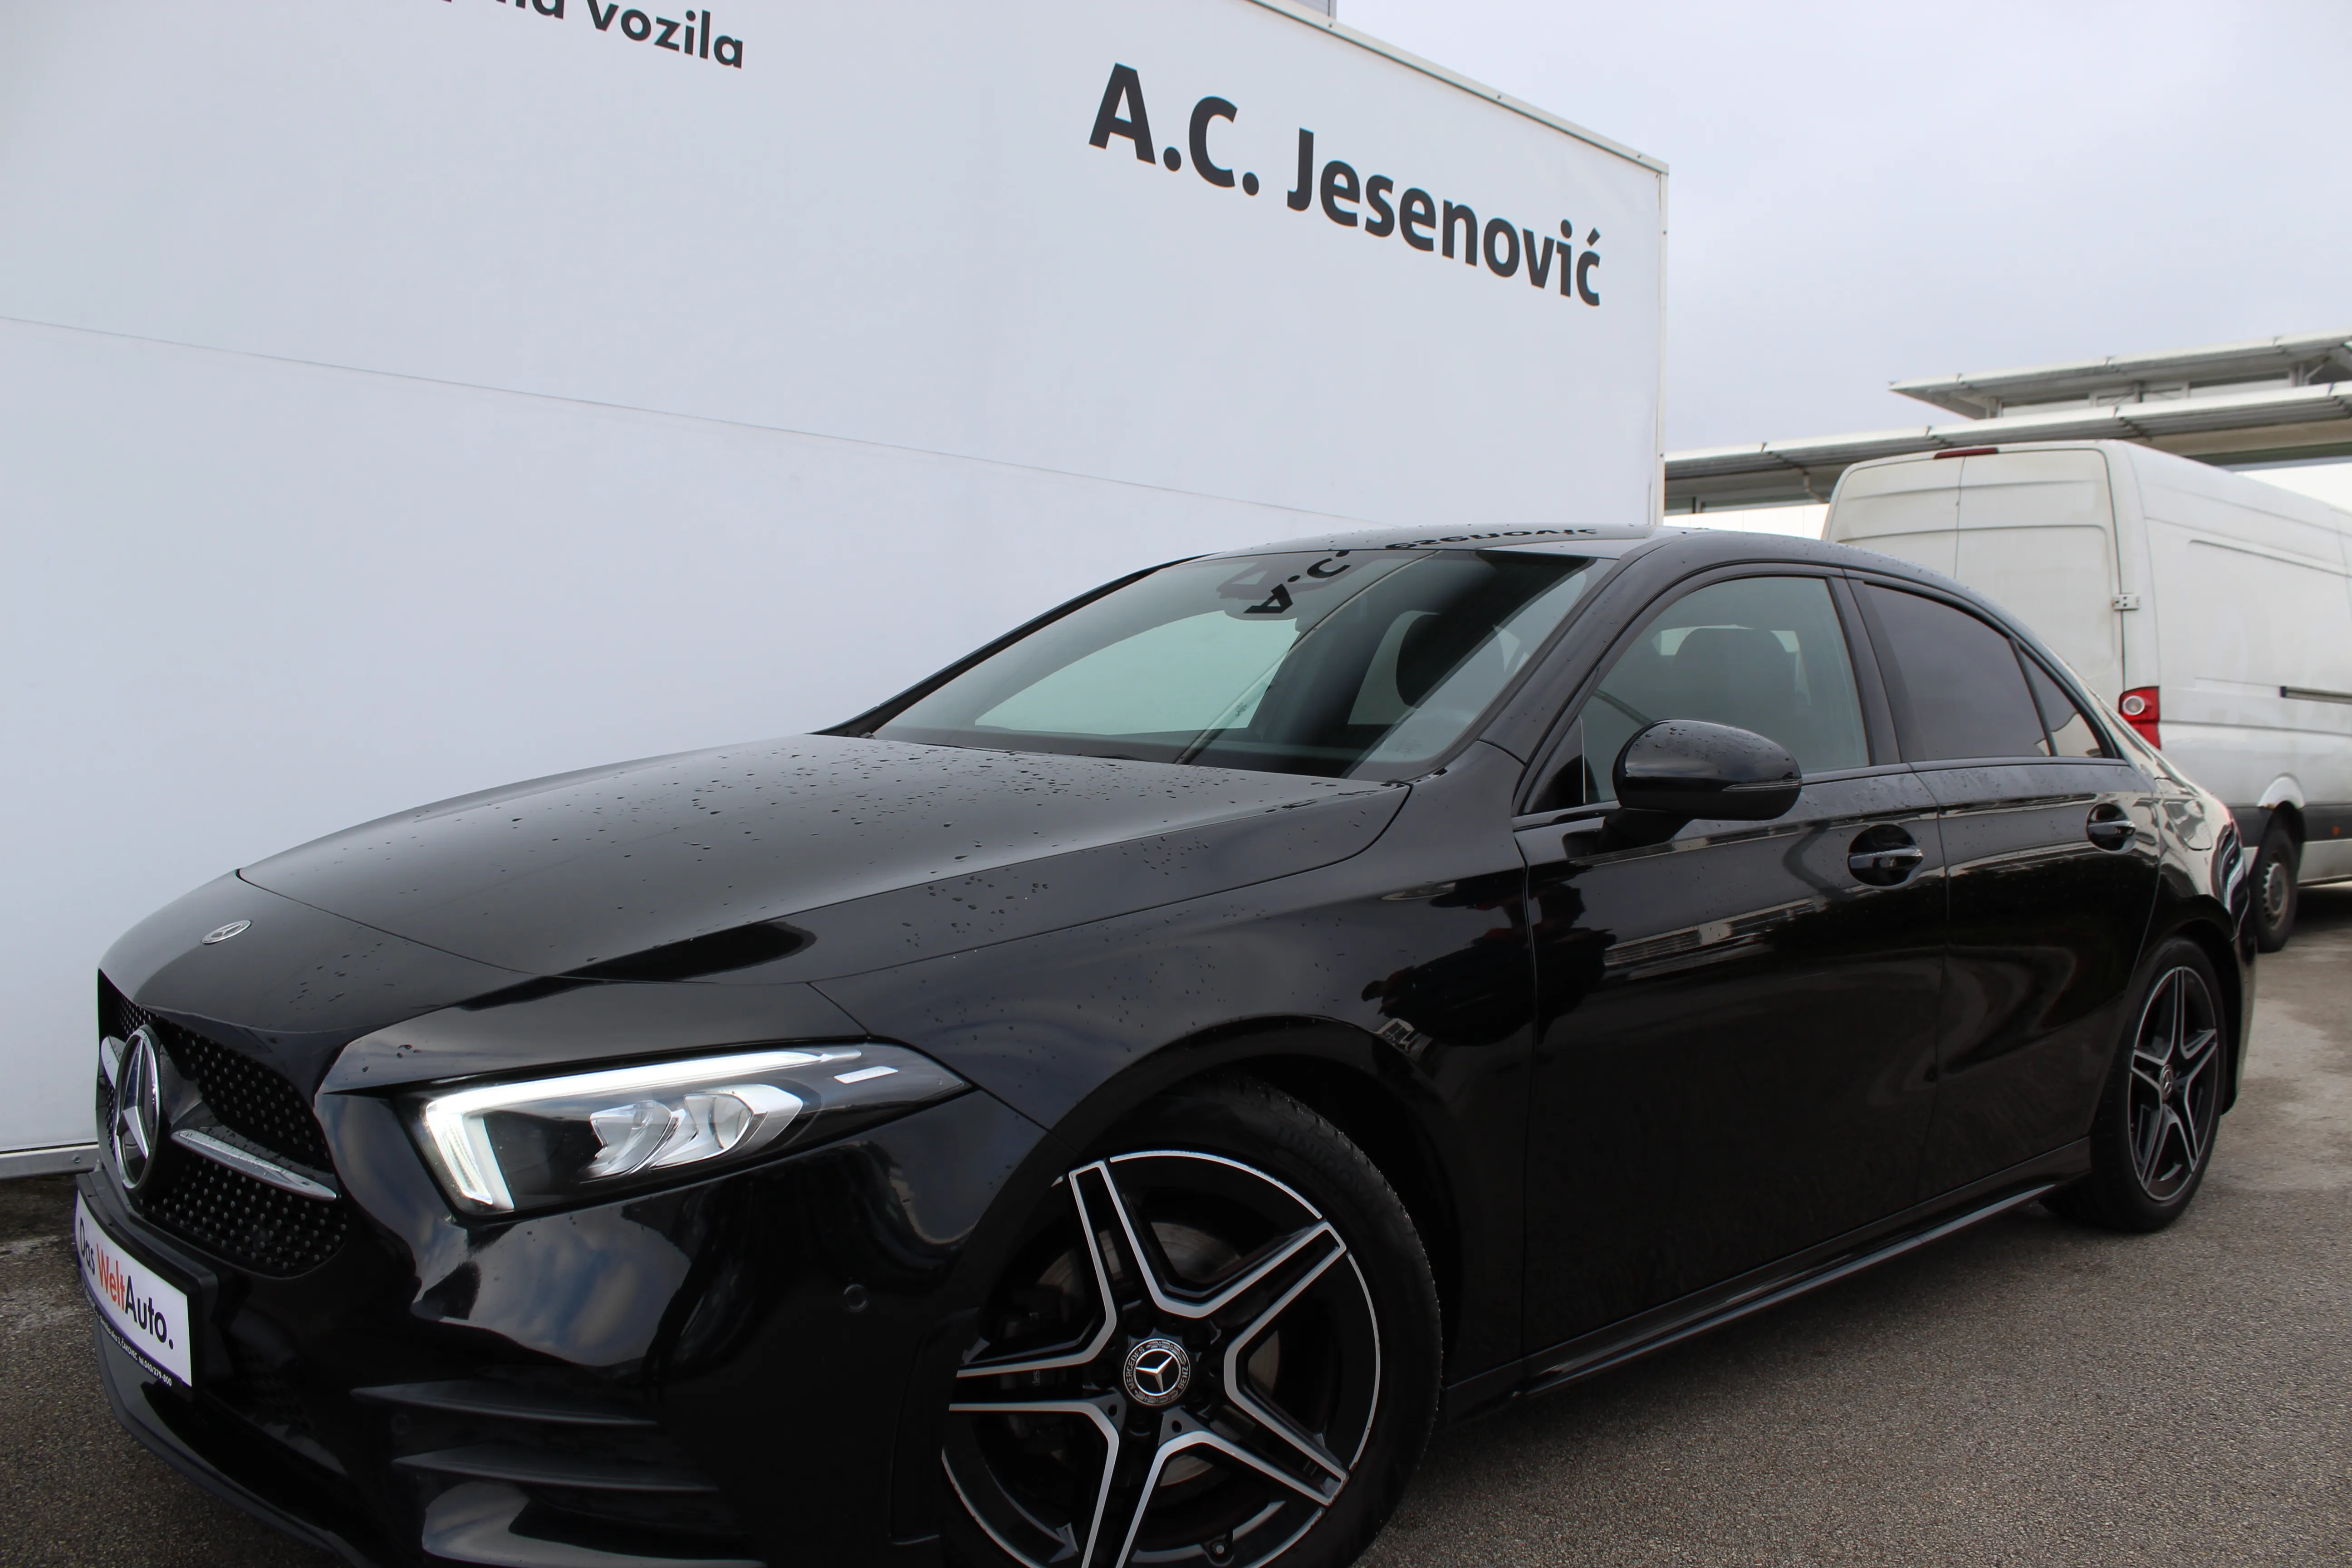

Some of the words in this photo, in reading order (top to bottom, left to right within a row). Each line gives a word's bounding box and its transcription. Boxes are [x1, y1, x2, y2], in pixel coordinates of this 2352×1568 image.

[586, 0, 743, 69] vozila
[1088, 63, 1259, 196] A.C.
[1287, 127, 1601, 307] Jesenović
[80, 1216, 95, 1275] Das
[96, 1242, 174, 1350] WeltAuto.
[1126, 1347, 1145, 1390] MERCEDES
[1178, 1366, 1189, 1390] BENZ
